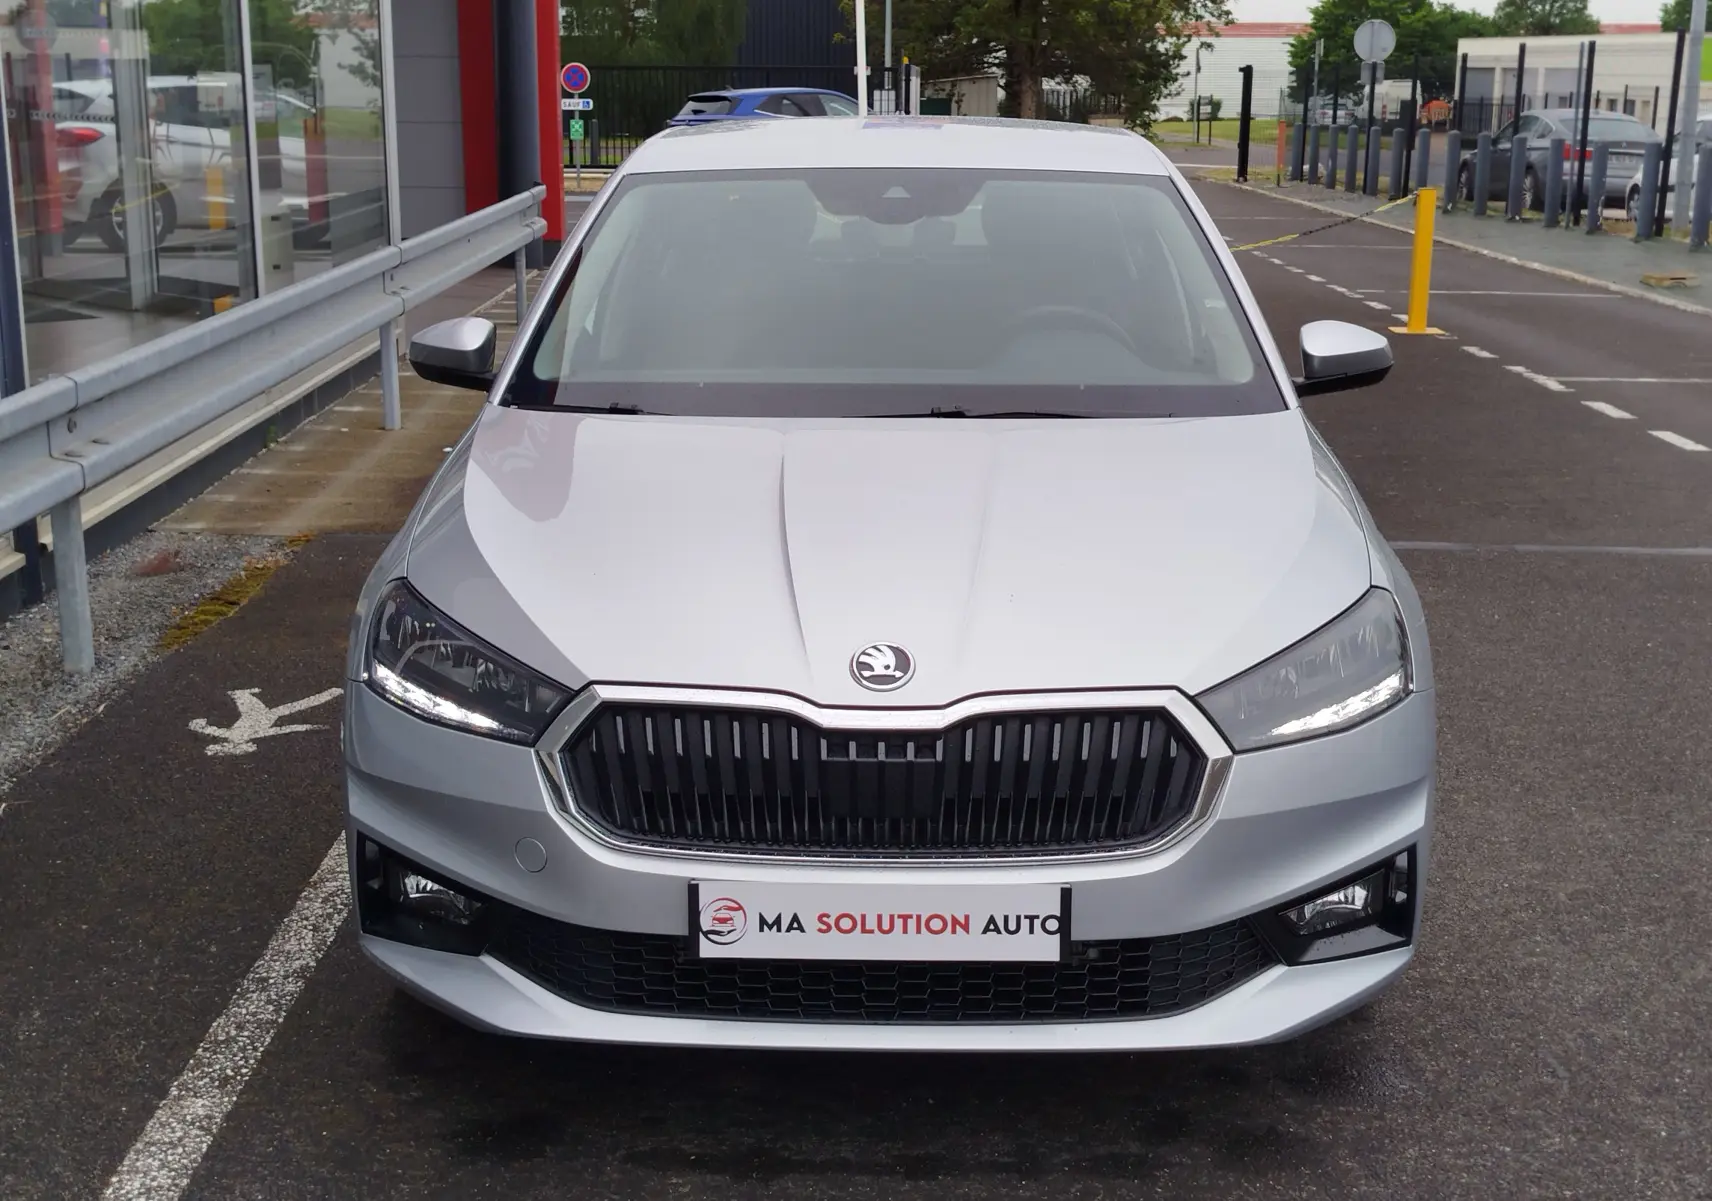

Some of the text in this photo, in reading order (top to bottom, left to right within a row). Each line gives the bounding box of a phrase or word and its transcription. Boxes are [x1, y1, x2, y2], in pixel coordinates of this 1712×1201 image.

[758, 911, 1062, 936] MA SOLUTION AUTO
